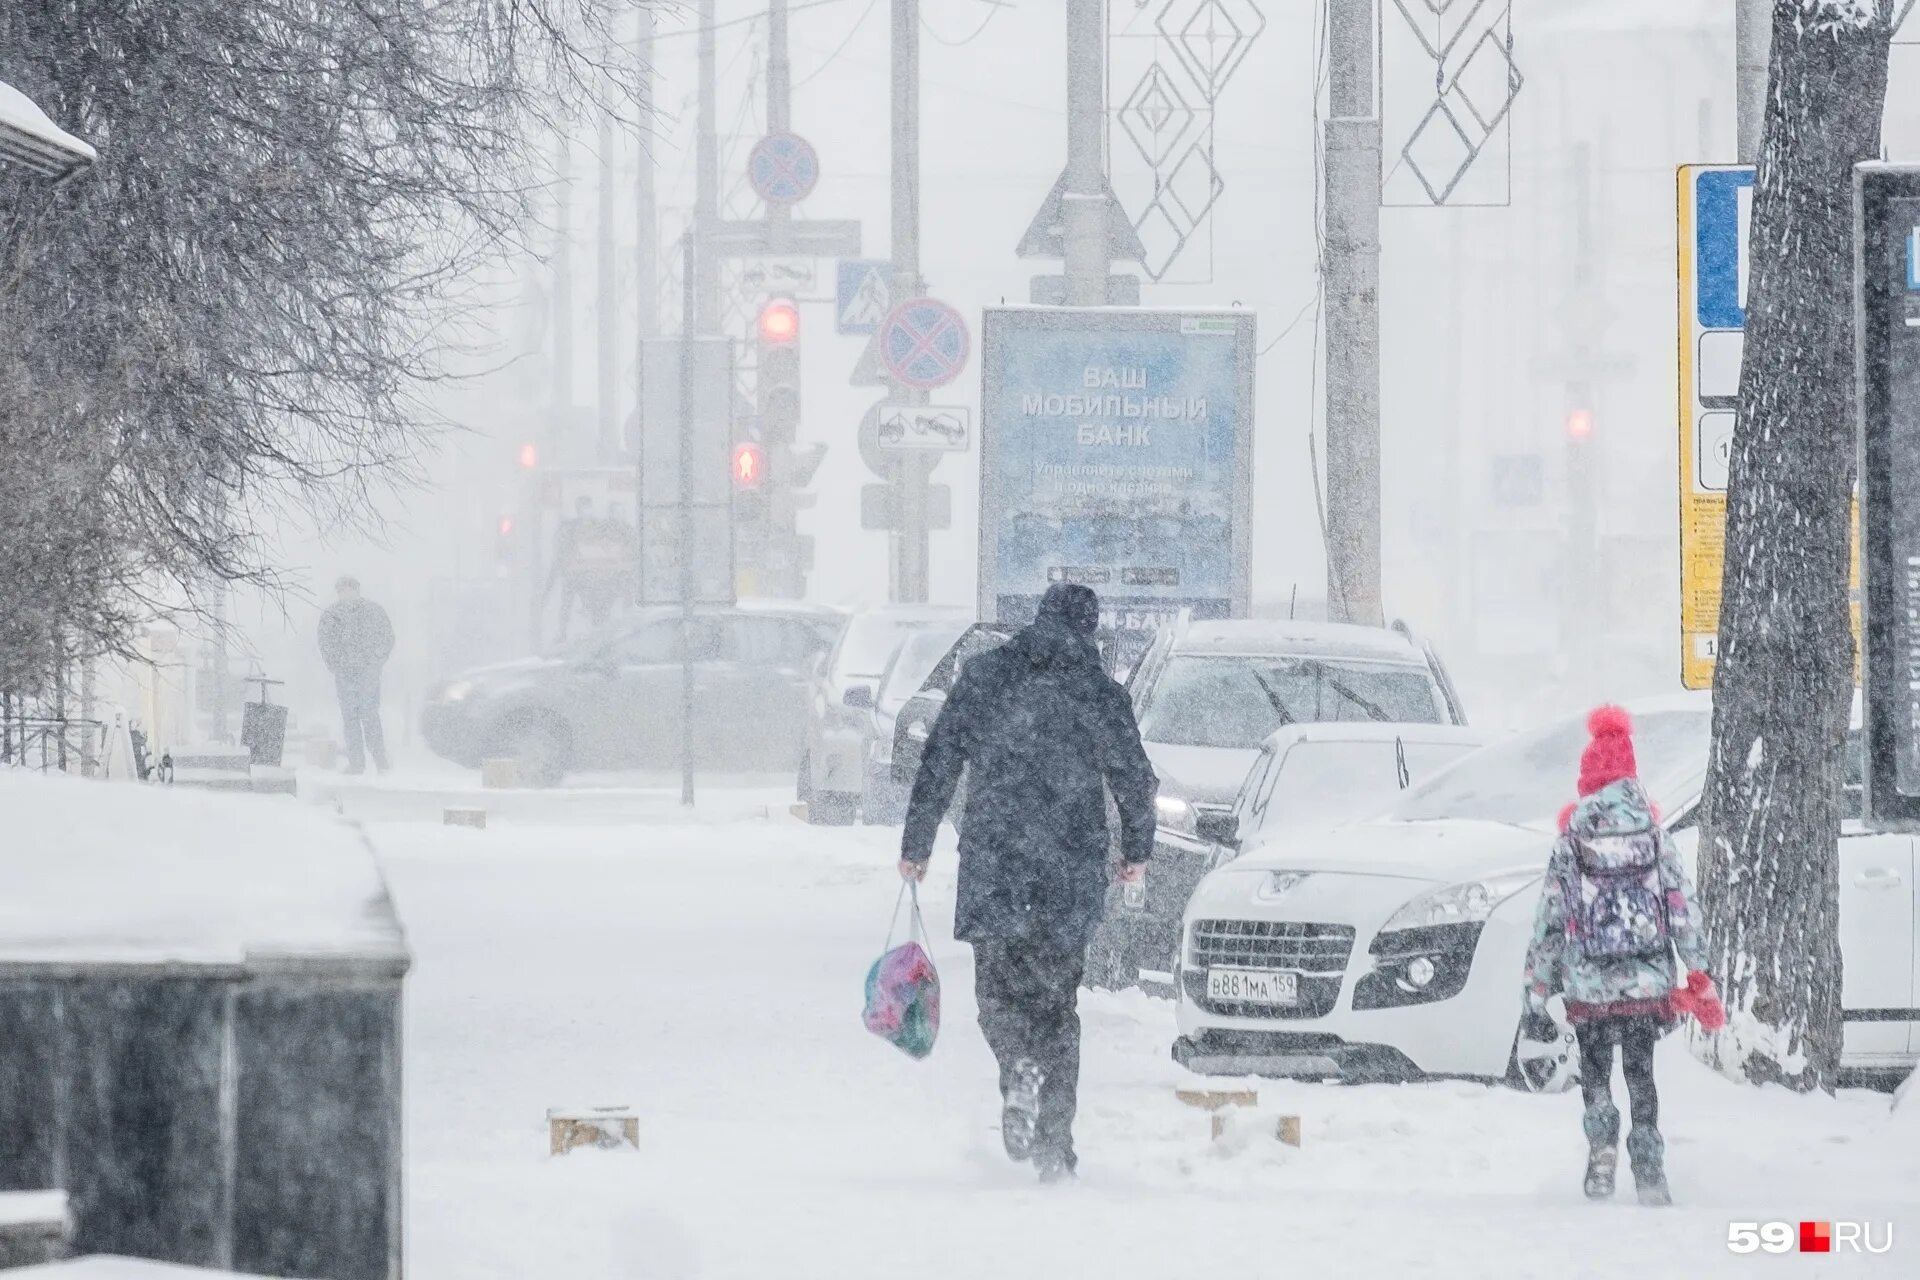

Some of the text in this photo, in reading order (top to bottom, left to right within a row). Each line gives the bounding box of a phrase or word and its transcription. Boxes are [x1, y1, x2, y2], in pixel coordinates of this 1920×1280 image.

[1083, 366, 1147, 390] ВАШ
[1022, 394, 1207, 420] МОБИЛЬНЫЙ
[1077, 424, 1151, 446] БАНК
[1272, 975, 1294, 993] 159
